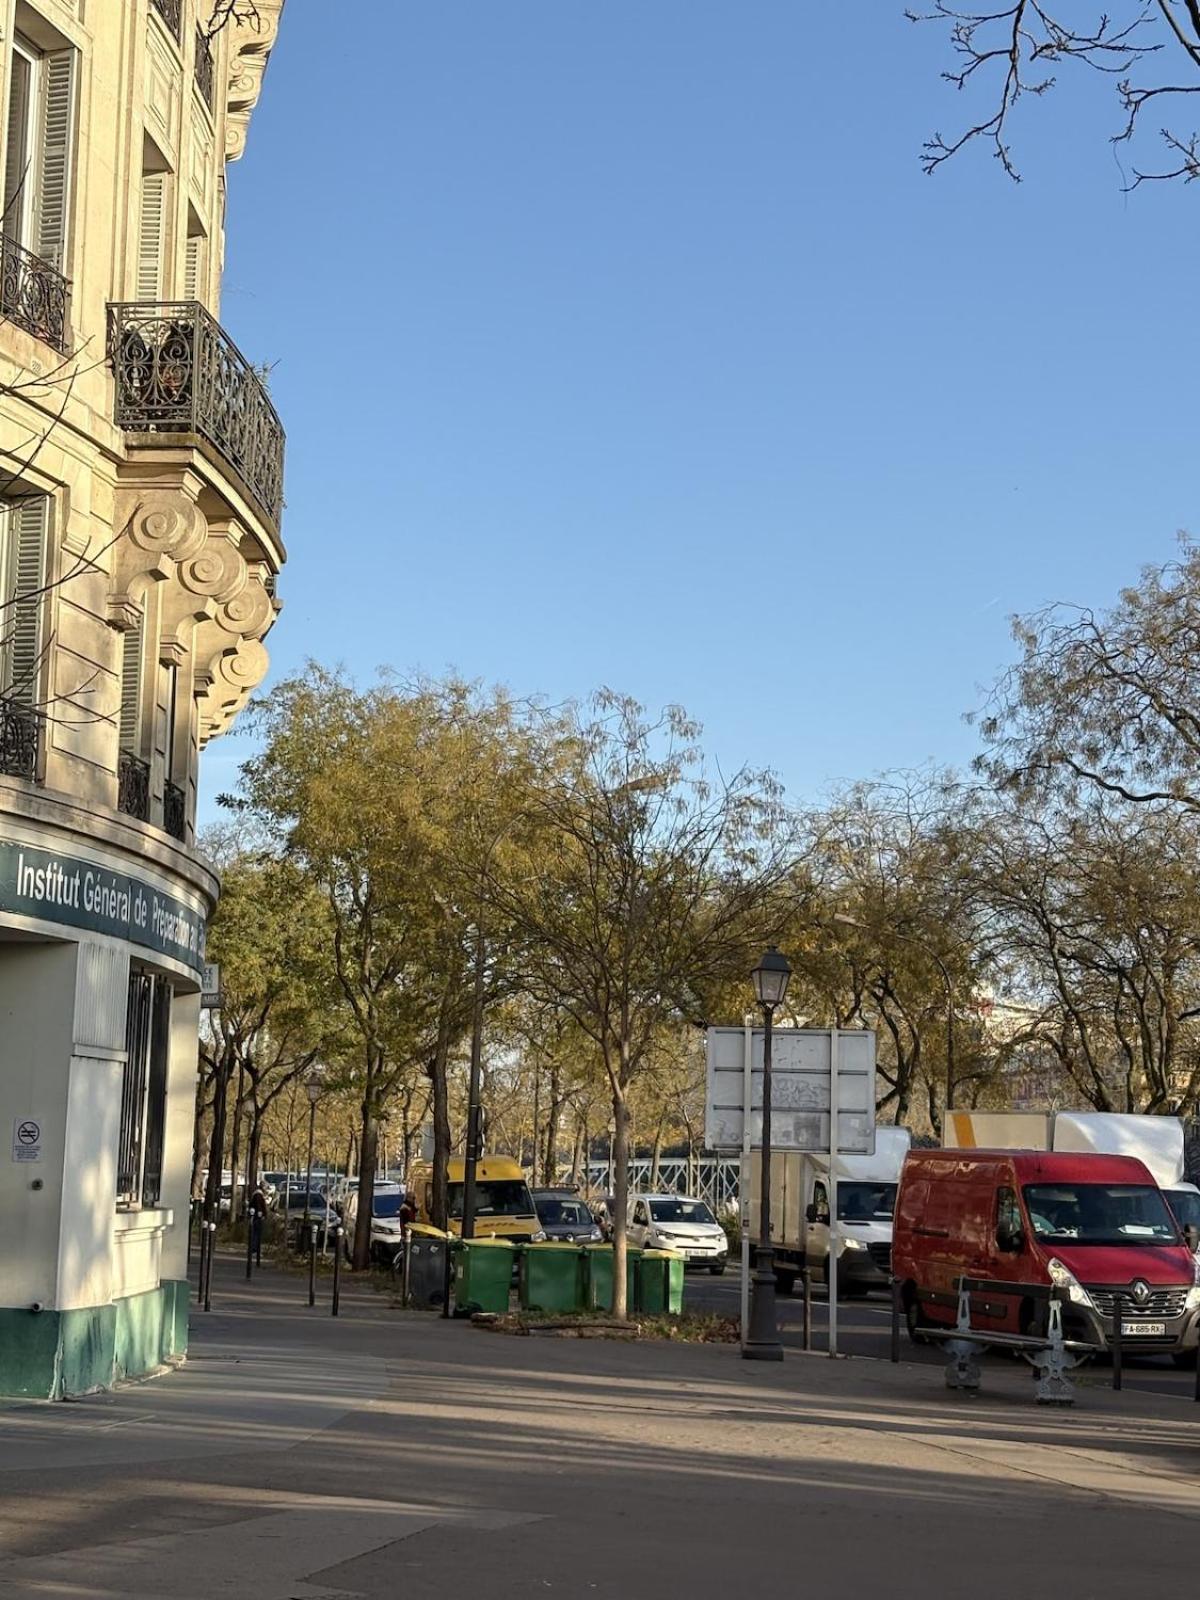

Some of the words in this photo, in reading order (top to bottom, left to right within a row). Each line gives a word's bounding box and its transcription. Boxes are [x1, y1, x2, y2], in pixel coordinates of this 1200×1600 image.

[17, 853, 80, 909] Institut
[83, 871, 132, 923] Général
[134, 888, 148, 928] de
